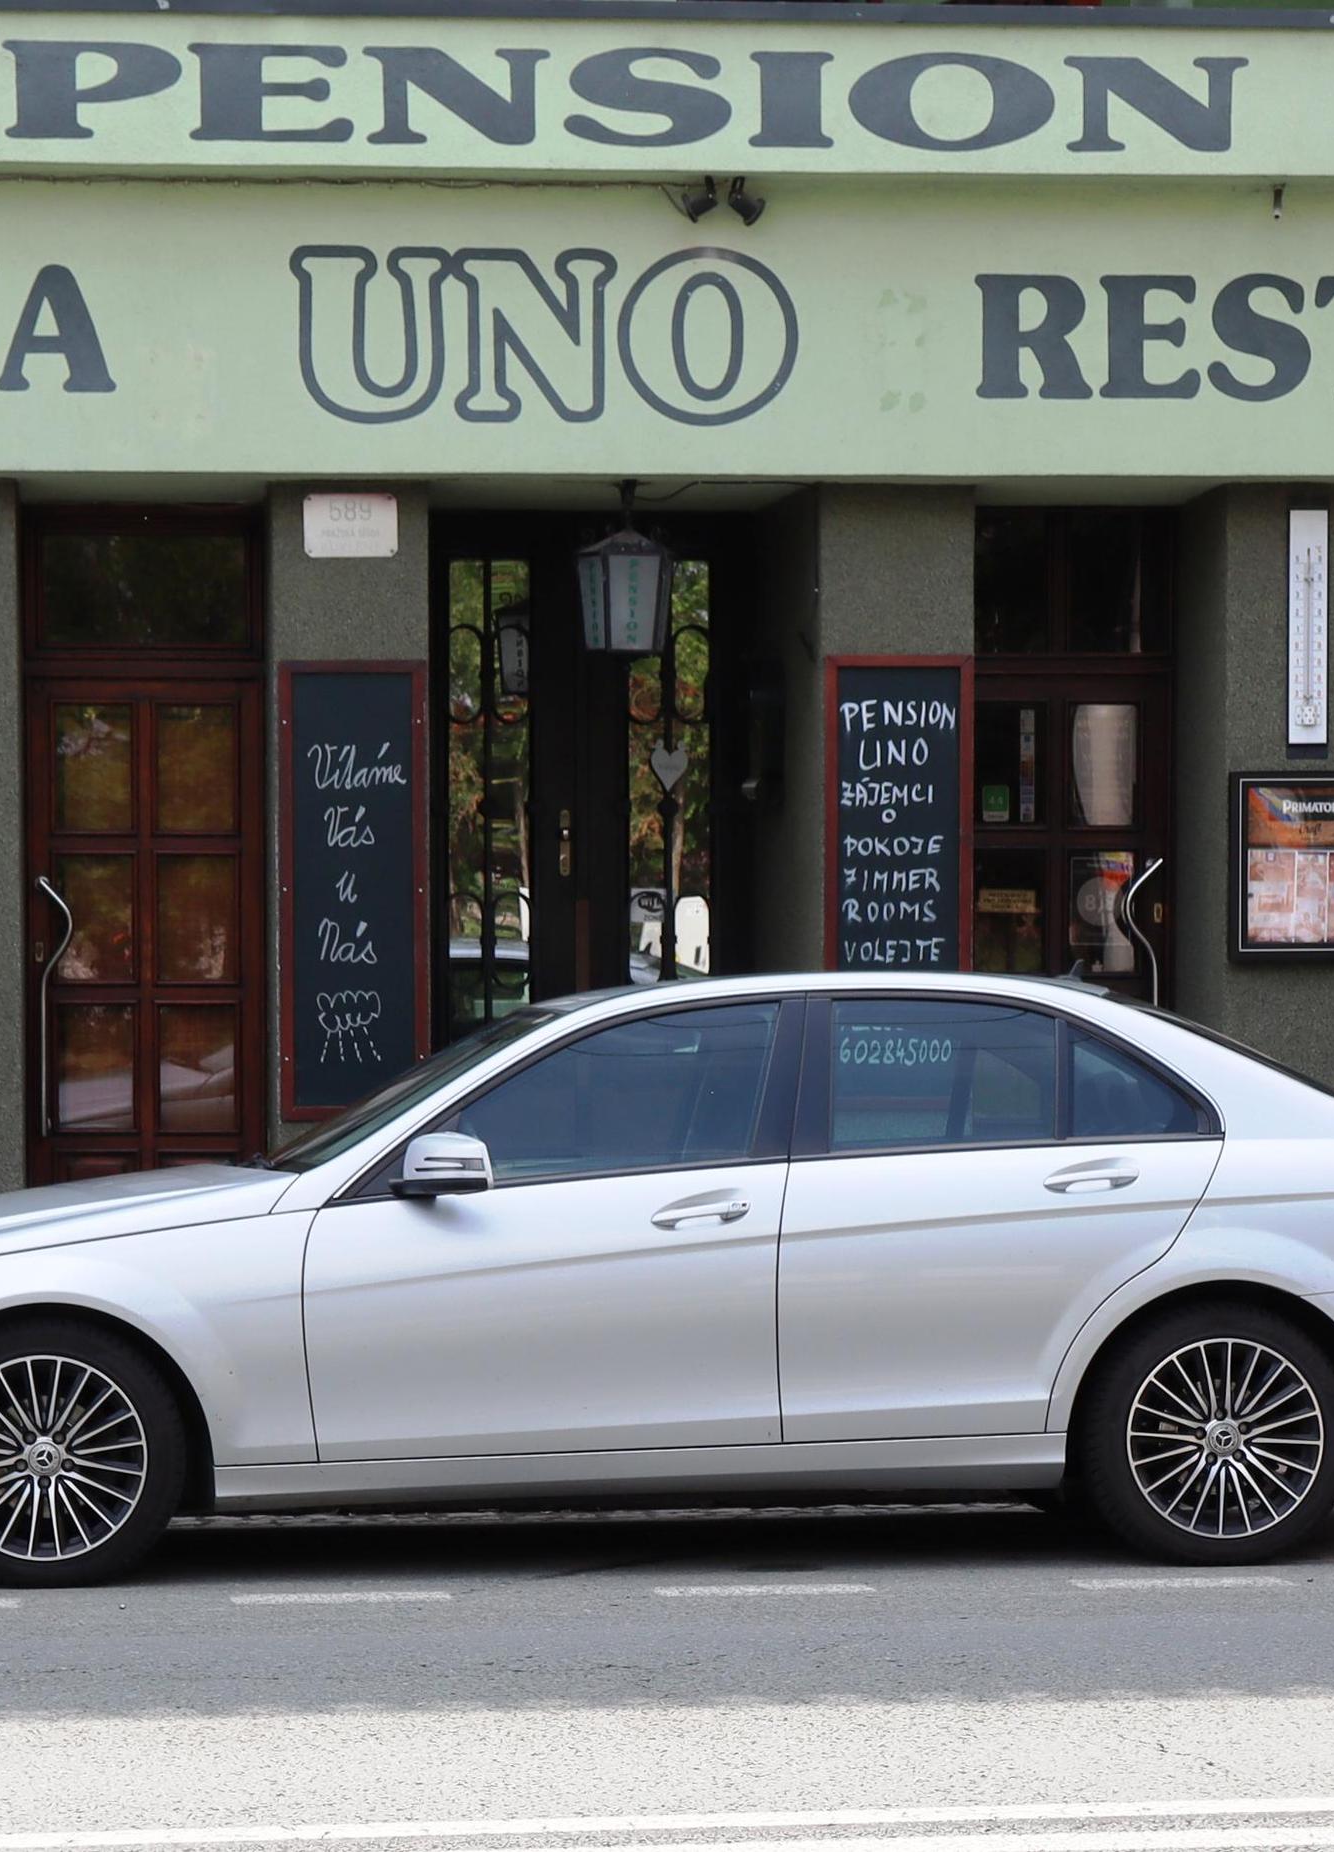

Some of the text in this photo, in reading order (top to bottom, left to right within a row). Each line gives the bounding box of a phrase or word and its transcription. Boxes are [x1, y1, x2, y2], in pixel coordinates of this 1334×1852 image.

[2, 39, 1249, 153] PENSION
[289, 245, 799, 426] UNO
[840, 699, 956, 733] PENSION
[307, 742, 407, 789] Vítáme
[859, 737, 929, 770] UNO
[841, 777, 934, 807] ZÁJEMCI
[324, 805, 375, 848] Vás
[843, 834, 944, 857] POKOJE
[844, 867, 941, 893] ZIMMER
[842, 898, 937, 923] ROOMS
[845, 938, 945, 963] VOLEJTE
[839, 1037, 952, 1067] 602845000
